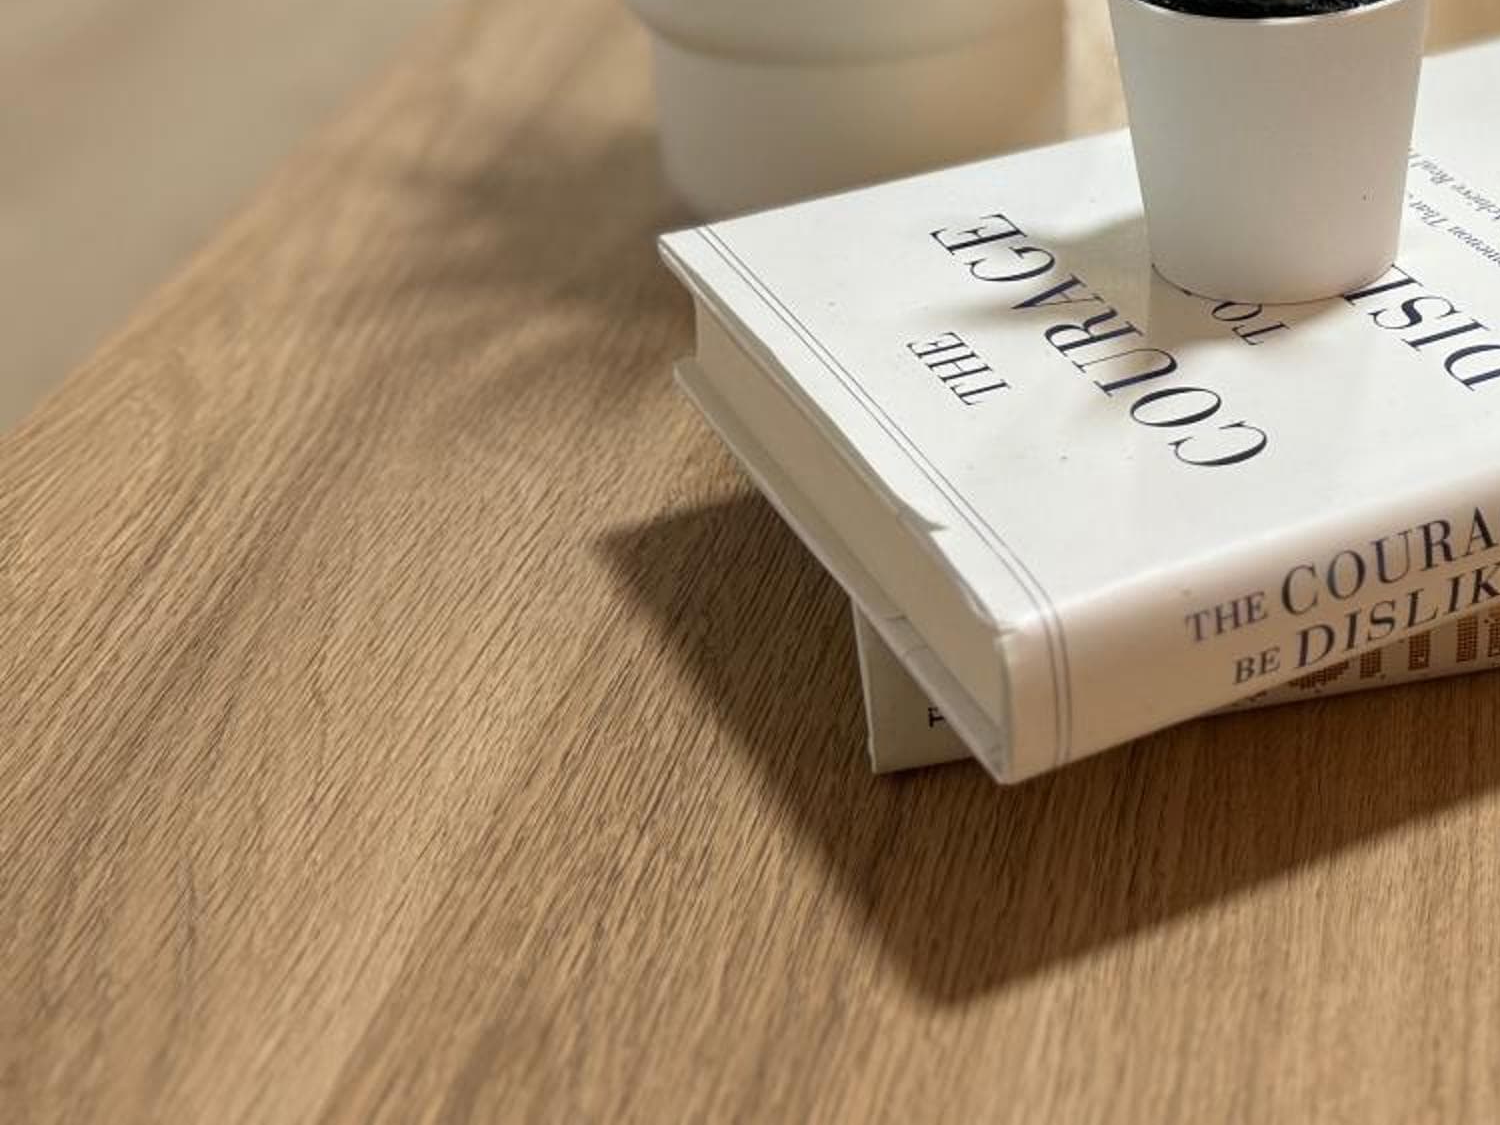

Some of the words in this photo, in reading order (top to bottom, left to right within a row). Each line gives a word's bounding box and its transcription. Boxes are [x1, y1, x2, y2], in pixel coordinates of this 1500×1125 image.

[929, 214, 1267, 467] COURAGE
[1210, 300, 1291, 346] TO
[907, 331, 1011, 406] THE
[1184, 592, 1268, 644] THE
[1232, 647, 1281, 685] BE
